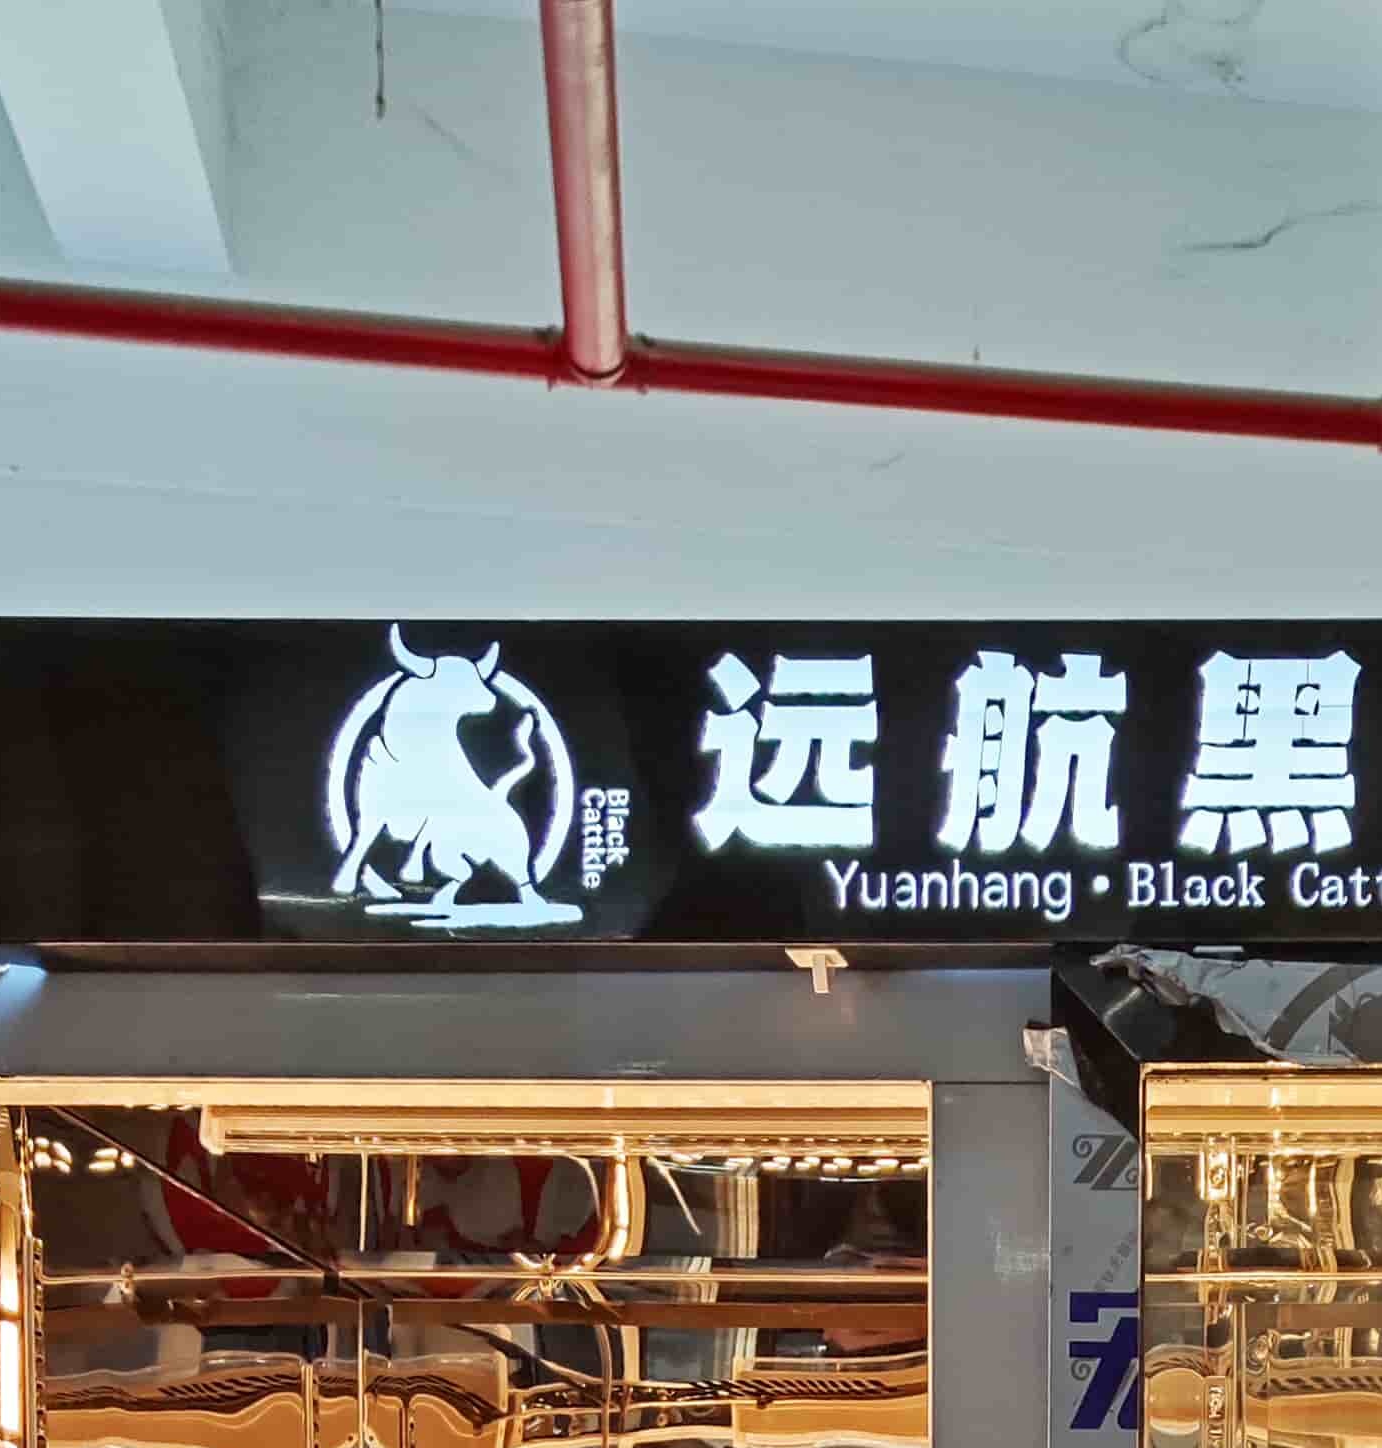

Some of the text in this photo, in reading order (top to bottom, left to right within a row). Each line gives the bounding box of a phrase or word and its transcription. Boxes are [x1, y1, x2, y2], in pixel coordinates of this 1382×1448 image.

[606, 788, 630, 867] Black
[825, 858, 1072, 922] Yuanhang
[1128, 860, 1266, 907] Black
